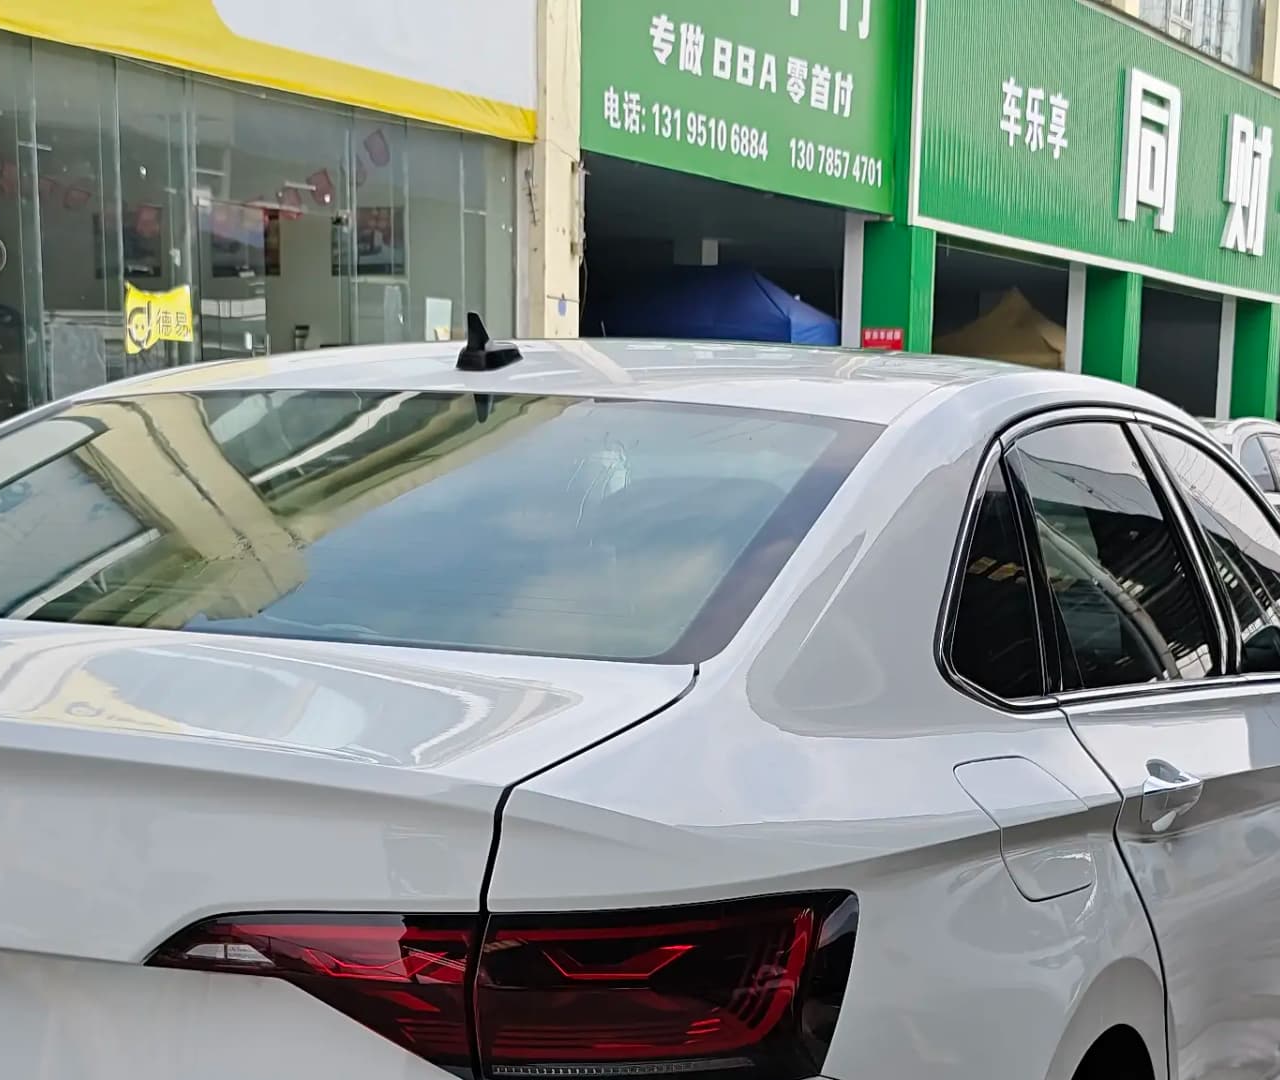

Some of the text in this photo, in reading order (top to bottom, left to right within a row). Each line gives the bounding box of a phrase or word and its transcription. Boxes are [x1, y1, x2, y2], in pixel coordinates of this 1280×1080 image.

[650, 14, 854, 117] 专做 BBA 零首付
[651, 103, 682, 141] 131
[686, 112, 727, 151] 9510
[730, 123, 768, 161] 6884
[790, 137, 815, 171] 130
[818, 144, 850, 180] 7857
[852, 153, 883, 188] 4701
[1000, 76, 1070, 159] 车乐享
